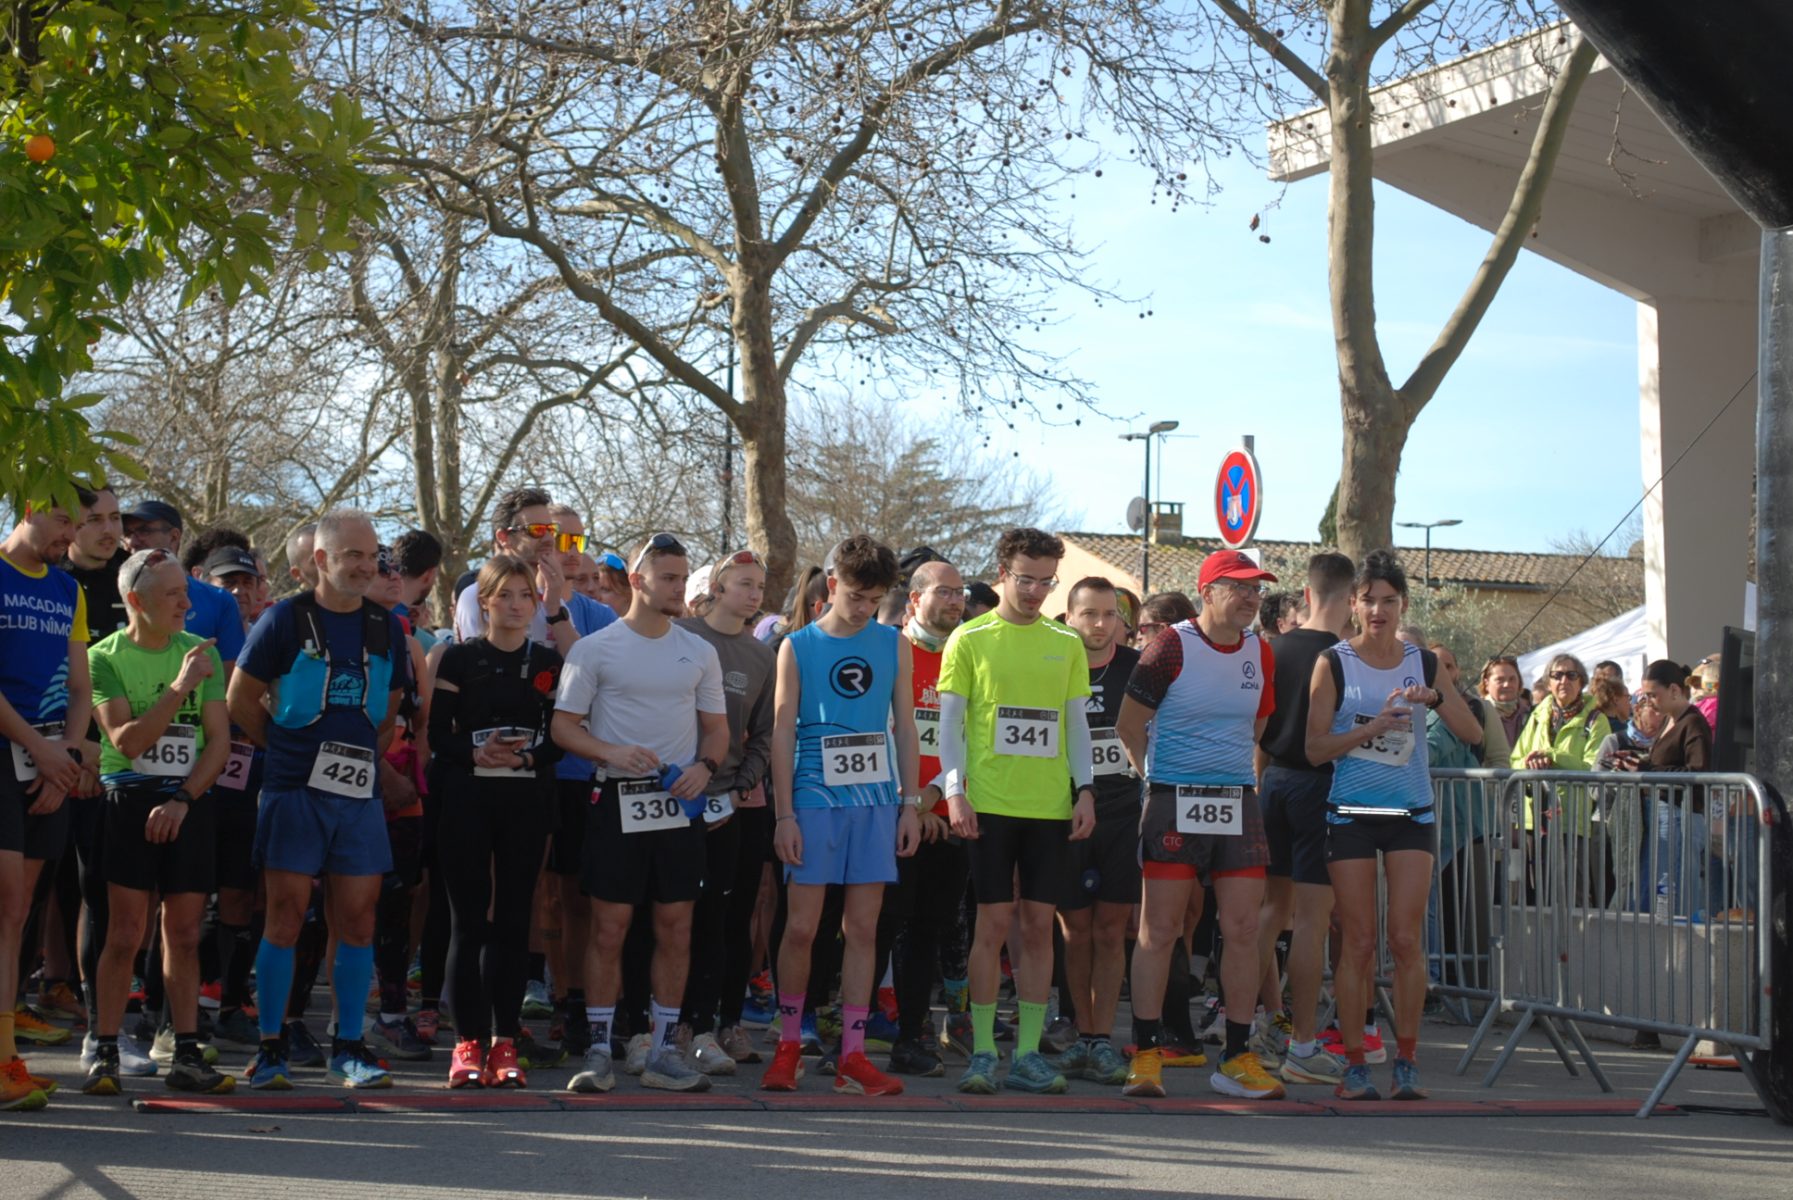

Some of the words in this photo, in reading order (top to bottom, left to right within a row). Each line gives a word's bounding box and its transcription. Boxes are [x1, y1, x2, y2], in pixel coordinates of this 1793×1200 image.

[0, 614, 37, 630] CLUB
[1004, 725, 1048, 747] 341
[142, 743, 190, 765] 465
[833, 752, 878, 774] 381
[322, 761, 368, 787] 426
[631, 797, 680, 820] 330
[703, 798, 723, 813] 6
[1185, 803, 1233, 824] 485
[1162, 835, 1183, 847] CTC
